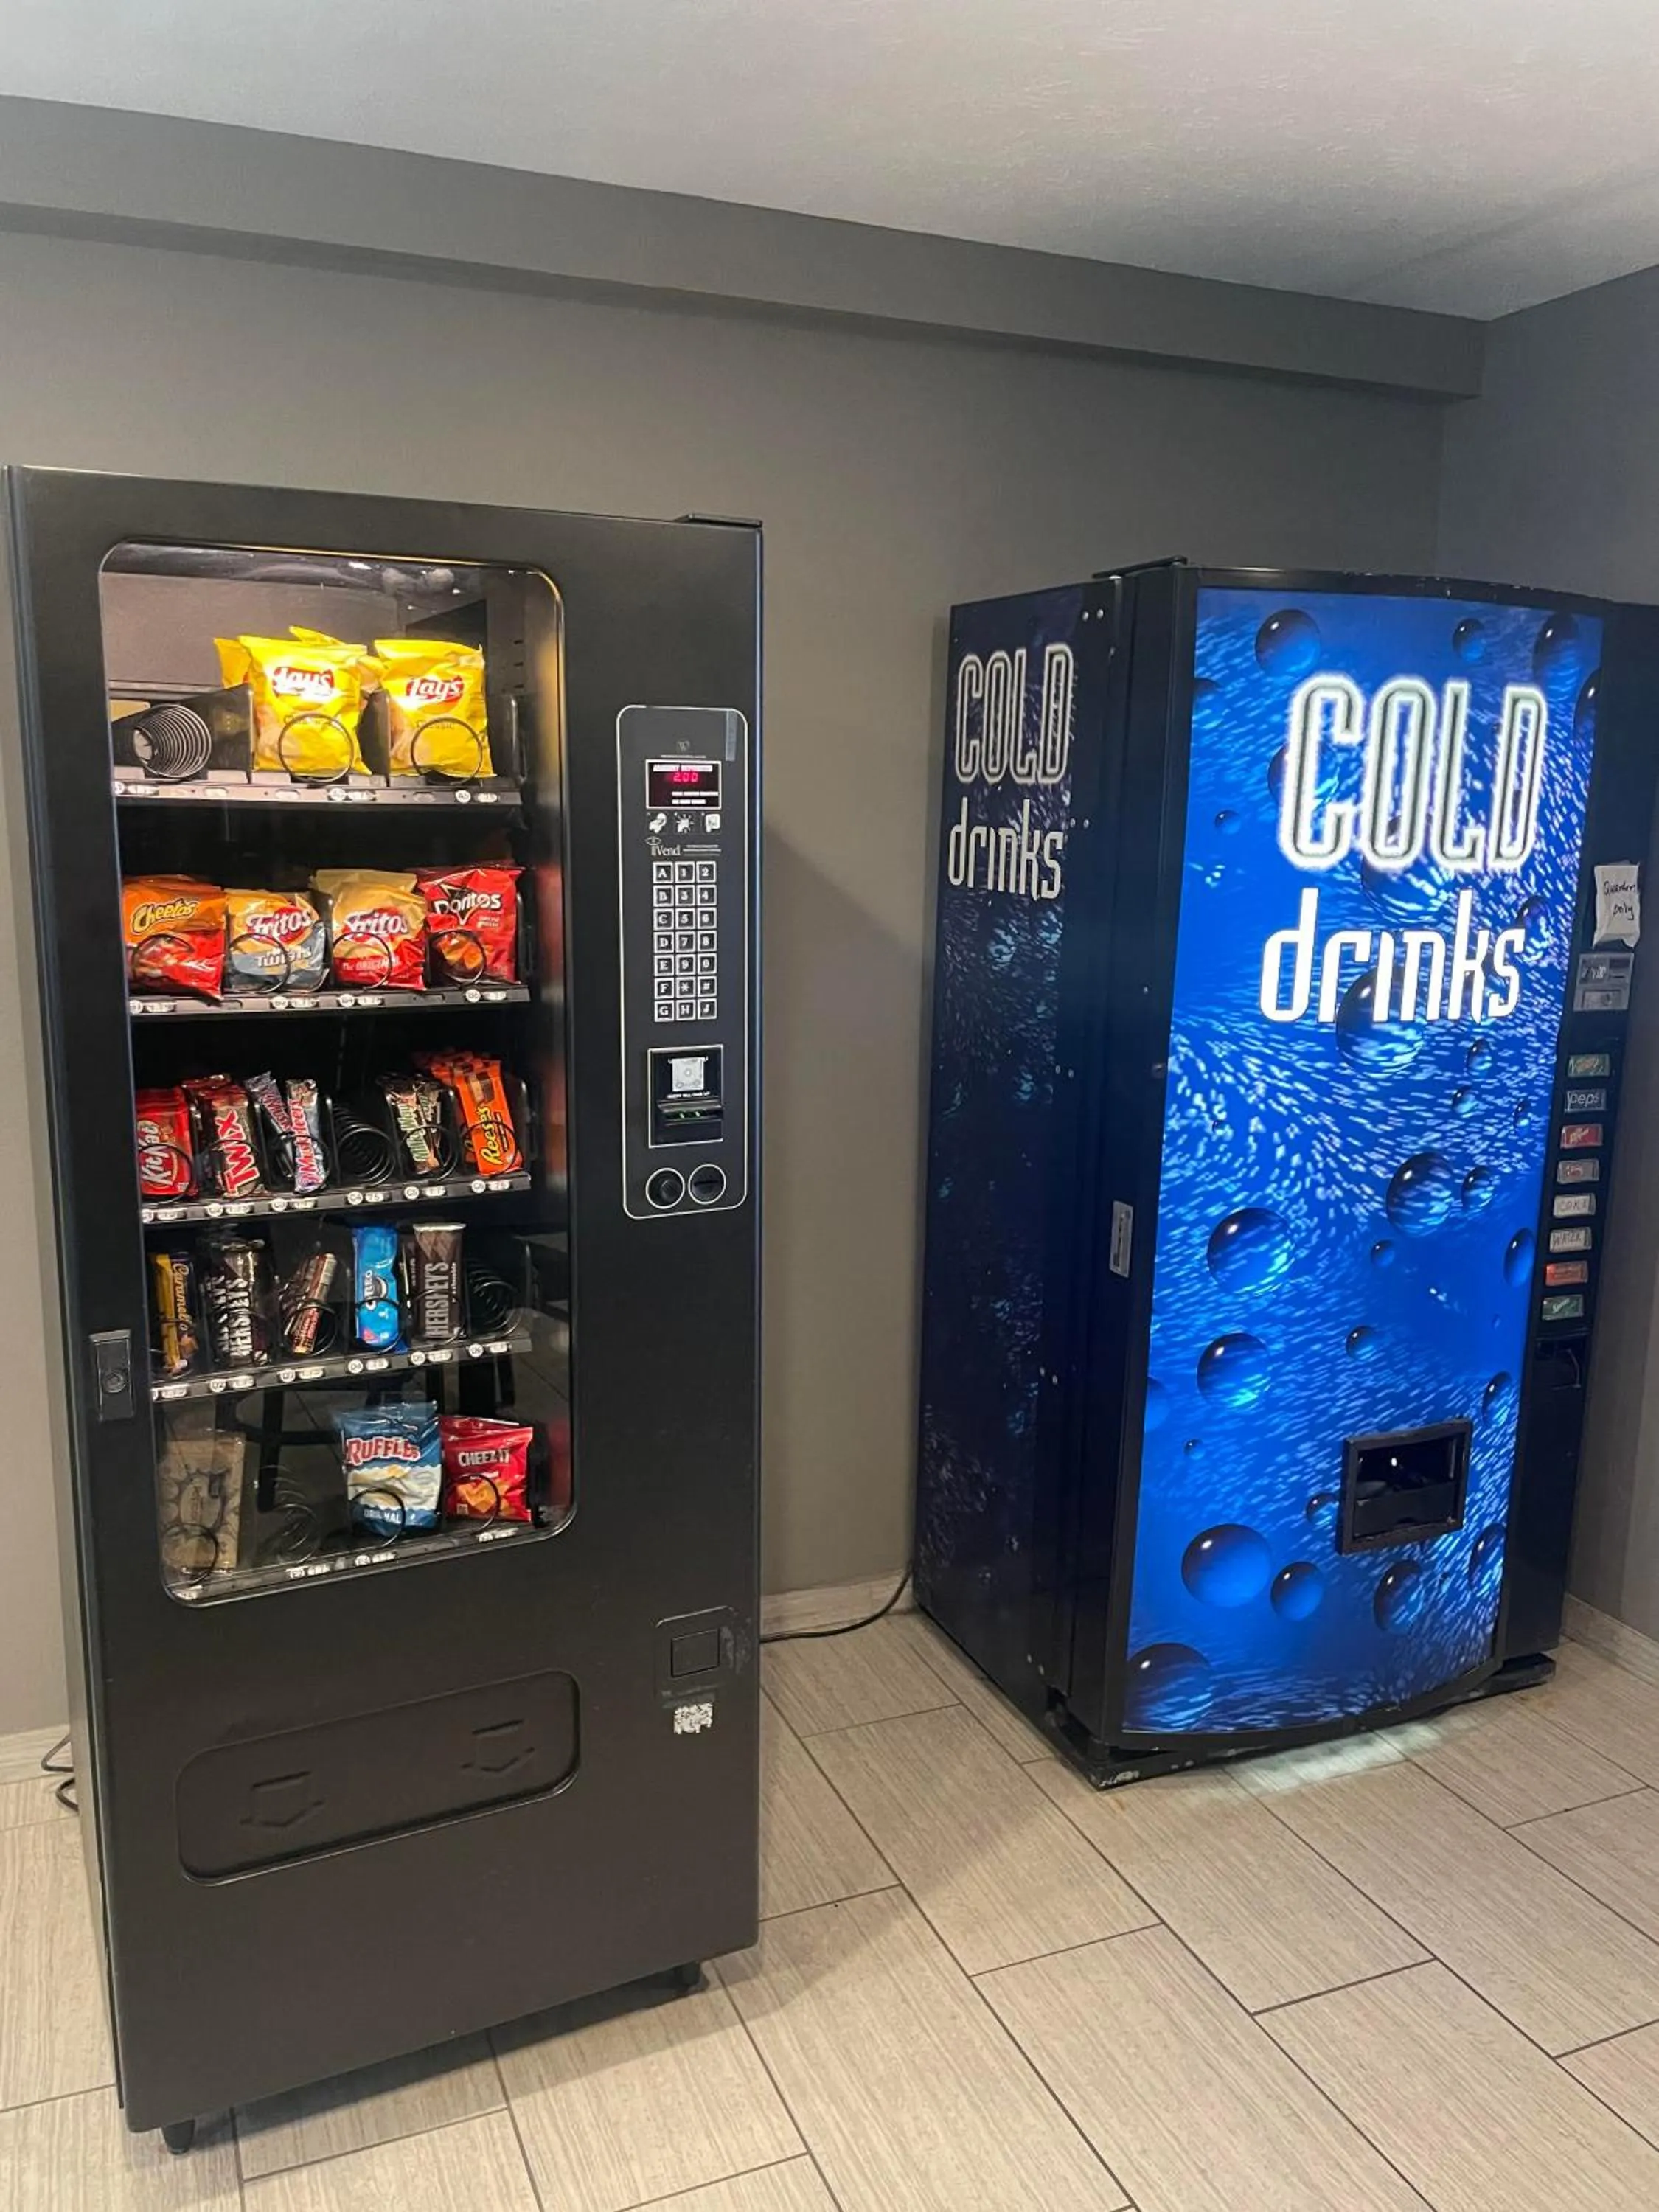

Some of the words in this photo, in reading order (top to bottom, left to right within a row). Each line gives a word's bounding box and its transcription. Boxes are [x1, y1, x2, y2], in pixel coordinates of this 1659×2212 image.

[406, 676, 464, 703] Lay's
[955, 643, 1074, 785] COLD
[1278, 672, 1548, 872] COLD
[947, 796, 1063, 900] drinks
[658, 868, 667, 878] A
[681, 868, 686, 877] 1
[701, 867, 709, 877] 2
[434, 893, 502, 915] Doritos
[681, 891, 688, 900] 3
[701, 890, 709, 900] 4
[132, 897, 198, 934] Cheetos
[247, 908, 313, 939] Fritos
[345, 910, 408, 935] Fritos
[658, 914, 667, 924] C
[681, 914, 689, 923] 5
[659, 937, 669, 947] D
[681, 937, 688, 947] 7
[660, 961, 669, 970] E
[1259, 887, 1525, 1023] drinks
[660, 983, 669, 993] F
[659, 1006, 669, 1015] G
[681, 1005, 690, 1015] H
[703, 1004, 709, 1014] J
[215, 1110, 259, 1197] TWIX
